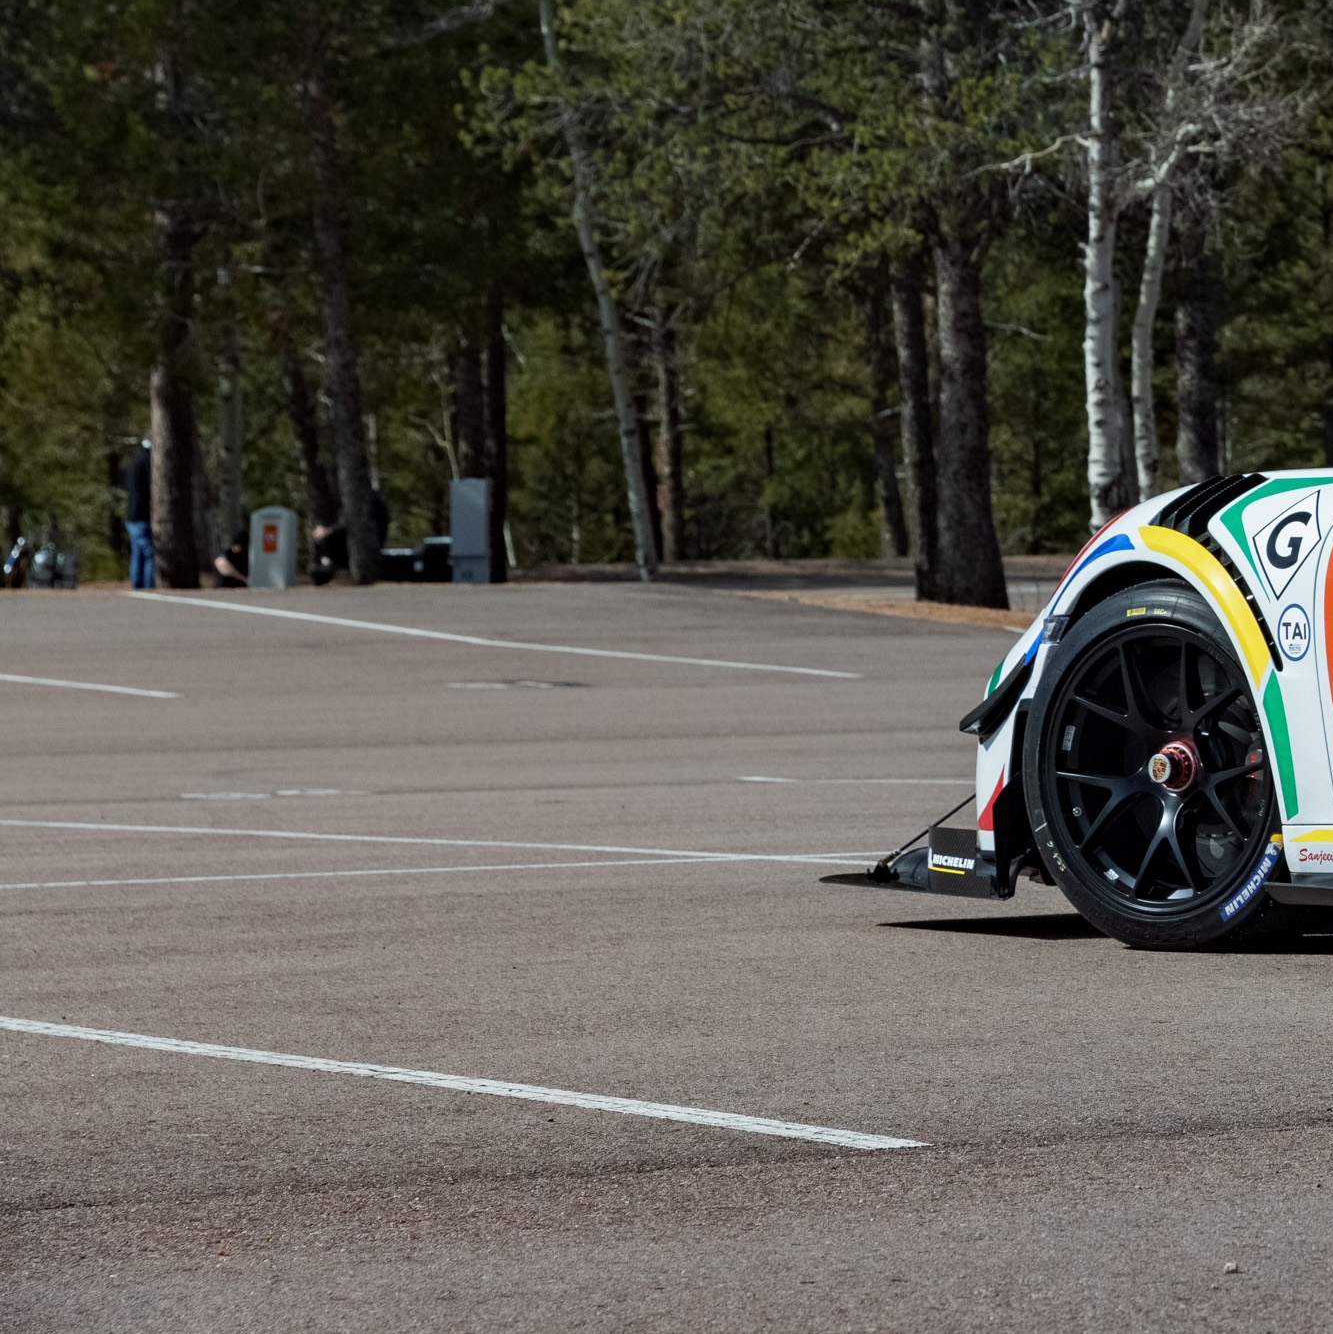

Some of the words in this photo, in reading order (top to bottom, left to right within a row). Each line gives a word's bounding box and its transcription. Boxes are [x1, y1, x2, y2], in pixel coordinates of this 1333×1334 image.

[1266, 511, 1313, 569] G
[1282, 621, 1307, 640] TAI
[932, 853, 976, 870] MICHELIN
[1224, 857, 1273, 916] MICHELIN
